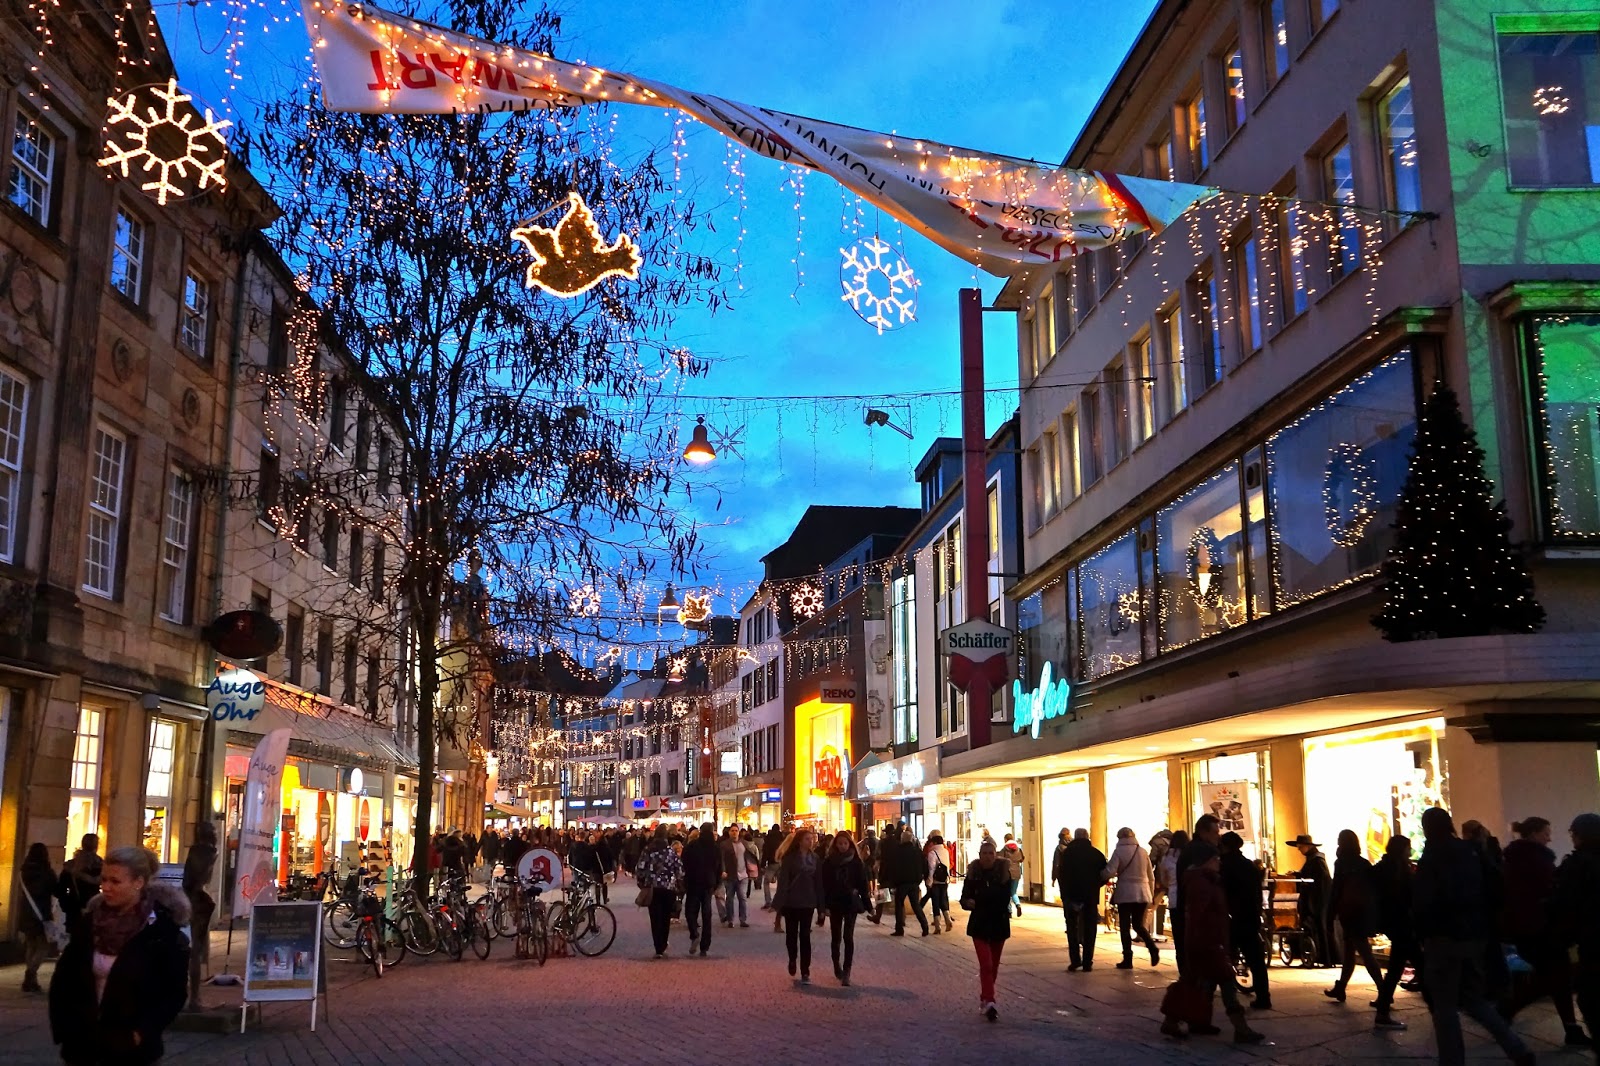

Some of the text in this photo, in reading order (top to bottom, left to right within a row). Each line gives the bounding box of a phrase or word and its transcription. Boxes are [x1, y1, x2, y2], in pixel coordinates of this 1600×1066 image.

[948, 632, 1010, 648] Schäffer
[205, 677, 265, 701] Auge
[823, 689, 856, 698] RENO
[212, 702, 260, 722] Ohr
[252, 756, 279, 777] Auge
[814, 755, 842, 790] RENO
